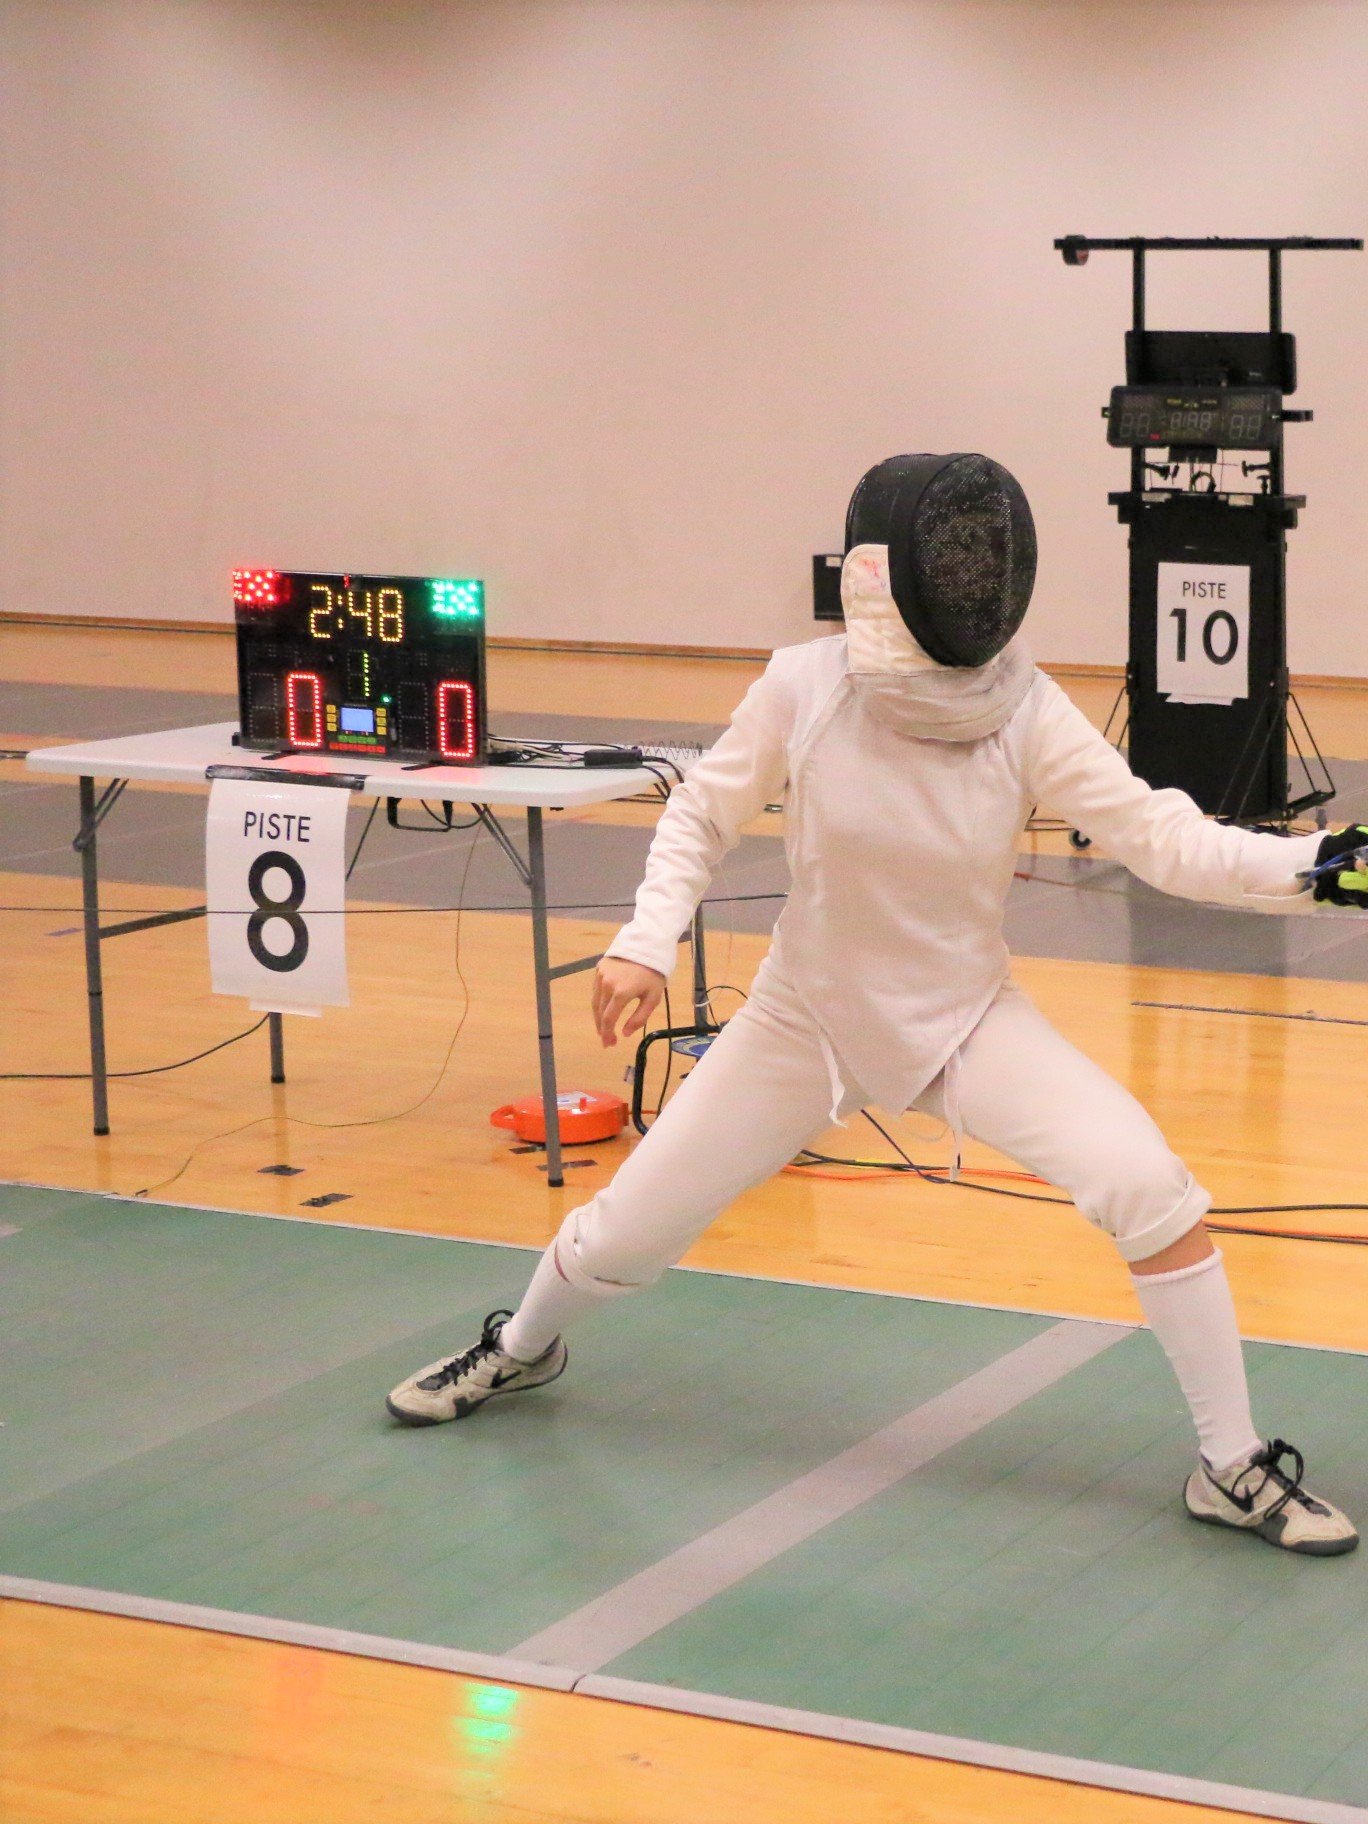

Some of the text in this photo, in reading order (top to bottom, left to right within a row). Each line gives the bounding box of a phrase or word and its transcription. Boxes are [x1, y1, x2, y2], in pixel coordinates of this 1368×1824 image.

[310, 585, 403, 643] 2:48
[1182, 581, 1227, 599] PISTE
[1169, 608, 1239, 665] 10
[287, 672, 321, 746] 0
[438, 682, 473, 758] 0
[243, 811, 311, 842] PISTE
[247, 851, 309, 972] 8
